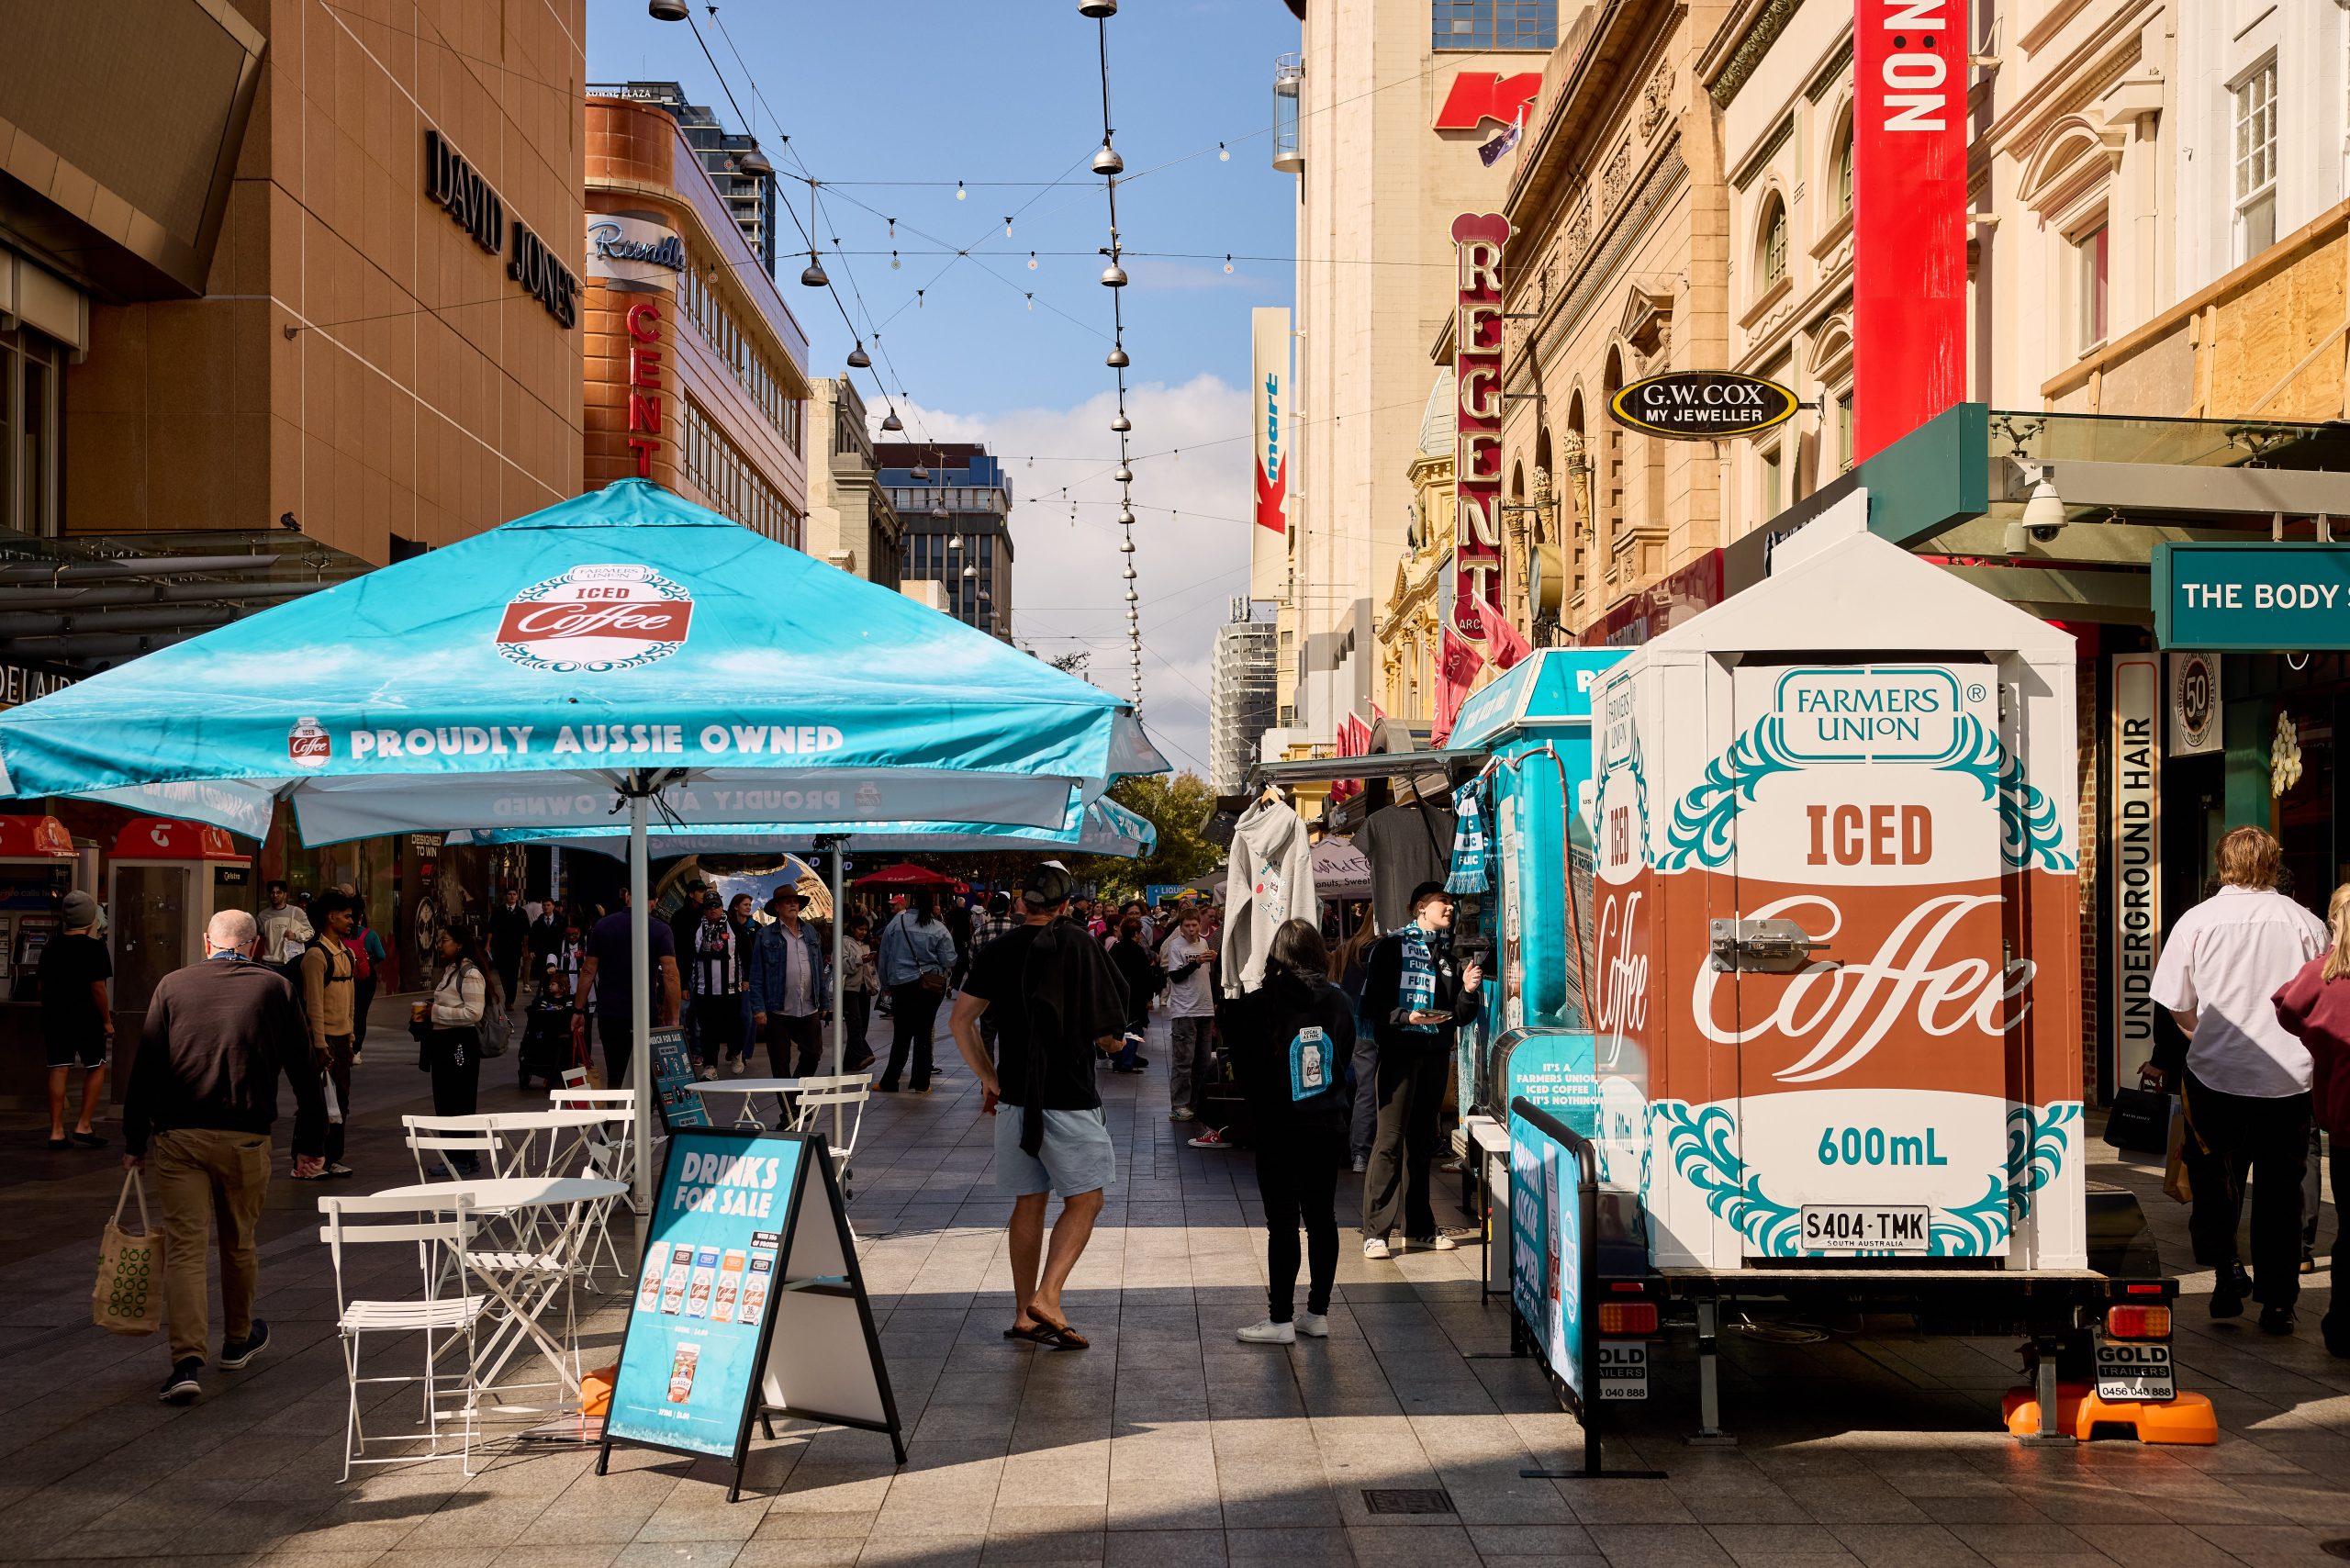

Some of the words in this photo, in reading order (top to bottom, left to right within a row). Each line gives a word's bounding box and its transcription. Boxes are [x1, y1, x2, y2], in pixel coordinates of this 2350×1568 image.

[586, 89, 620, 98] ROWNE
[425, 129, 504, 256] DAVID
[507, 220, 576, 330] JONES
[1704, 385, 1764, 405] COX
[1646, 409, 1668, 422] MY
[1673, 409, 1762, 422] JEWELLER
[1458, 240, 1503, 612] REGENT
[576, 588, 631, 599] ICED
[2181, 583, 2243, 609] THE
[2255, 583, 2340, 610] BODY
[517, 602, 673, 638] Coffee
[1796, 686, 1940, 714] FARMERS
[2187, 675, 2206, 718] 50
[1608, 691, 1630, 725] FARMERS
[1818, 715, 1920, 743] UNION
[291, 737, 328, 756] Coffee
[351, 726, 534, 759] PROUDLY
[552, 724, 684, 754] AUSSIE
[699, 724, 844, 755] OWNED
[2123, 717, 2151, 790] HAIR
[411, 834, 442, 846] DESIGNED
[1609, 805, 1630, 868] ICED
[1807, 803, 1933, 867] ICED
[416, 846, 424, 856] TO
[424, 846, 437, 857] WIN
[1315, 879, 1340, 889] onuts,
[2123, 800, 2152, 1039] UNDERGROUND
[1407, 975, 1430, 988] FUIC
[1597, 890, 1650, 1069] Coffee
[1692, 893, 2038, 1083] Coffee
[1406, 992, 1428, 1004] FUIC
[1542, 1063, 1560, 1072] IT'S
[1562, 1063, 1572, 1072] A
[1516, 1074, 1562, 1083] FARMERS
[1526, 1085, 1550, 1094] ICED
[1552, 1085, 1589, 1094] COFFEE
[1532, 1096, 1550, 1105] IT'S
[1818, 1126, 1948, 1167] 600mL
[679, 1151, 779, 1191] DRINKS
[673, 1183, 715, 1215] FOR
[720, 1188, 773, 1219] SALE
[690, 1283, 710, 1300] Coffee
[717, 1286, 736, 1303] Coffee
[744, 1291, 764, 1305] Coffee
[1598, 1349, 1645, 1364] OLD
[2097, 1347, 2168, 1362] GOLD
[1599, 1368, 1643, 1377] AILERS
[2102, 1367, 2166, 1376] TRAILERS
[1606, 1388, 1624, 1397] 040
[1627, 1388, 1646, 1397] 888
[2102, 1387, 2128, 1396] 0456
[2131, 1387, 2150, 1396] 040
[2152, 1387, 2172, 1396] 888
